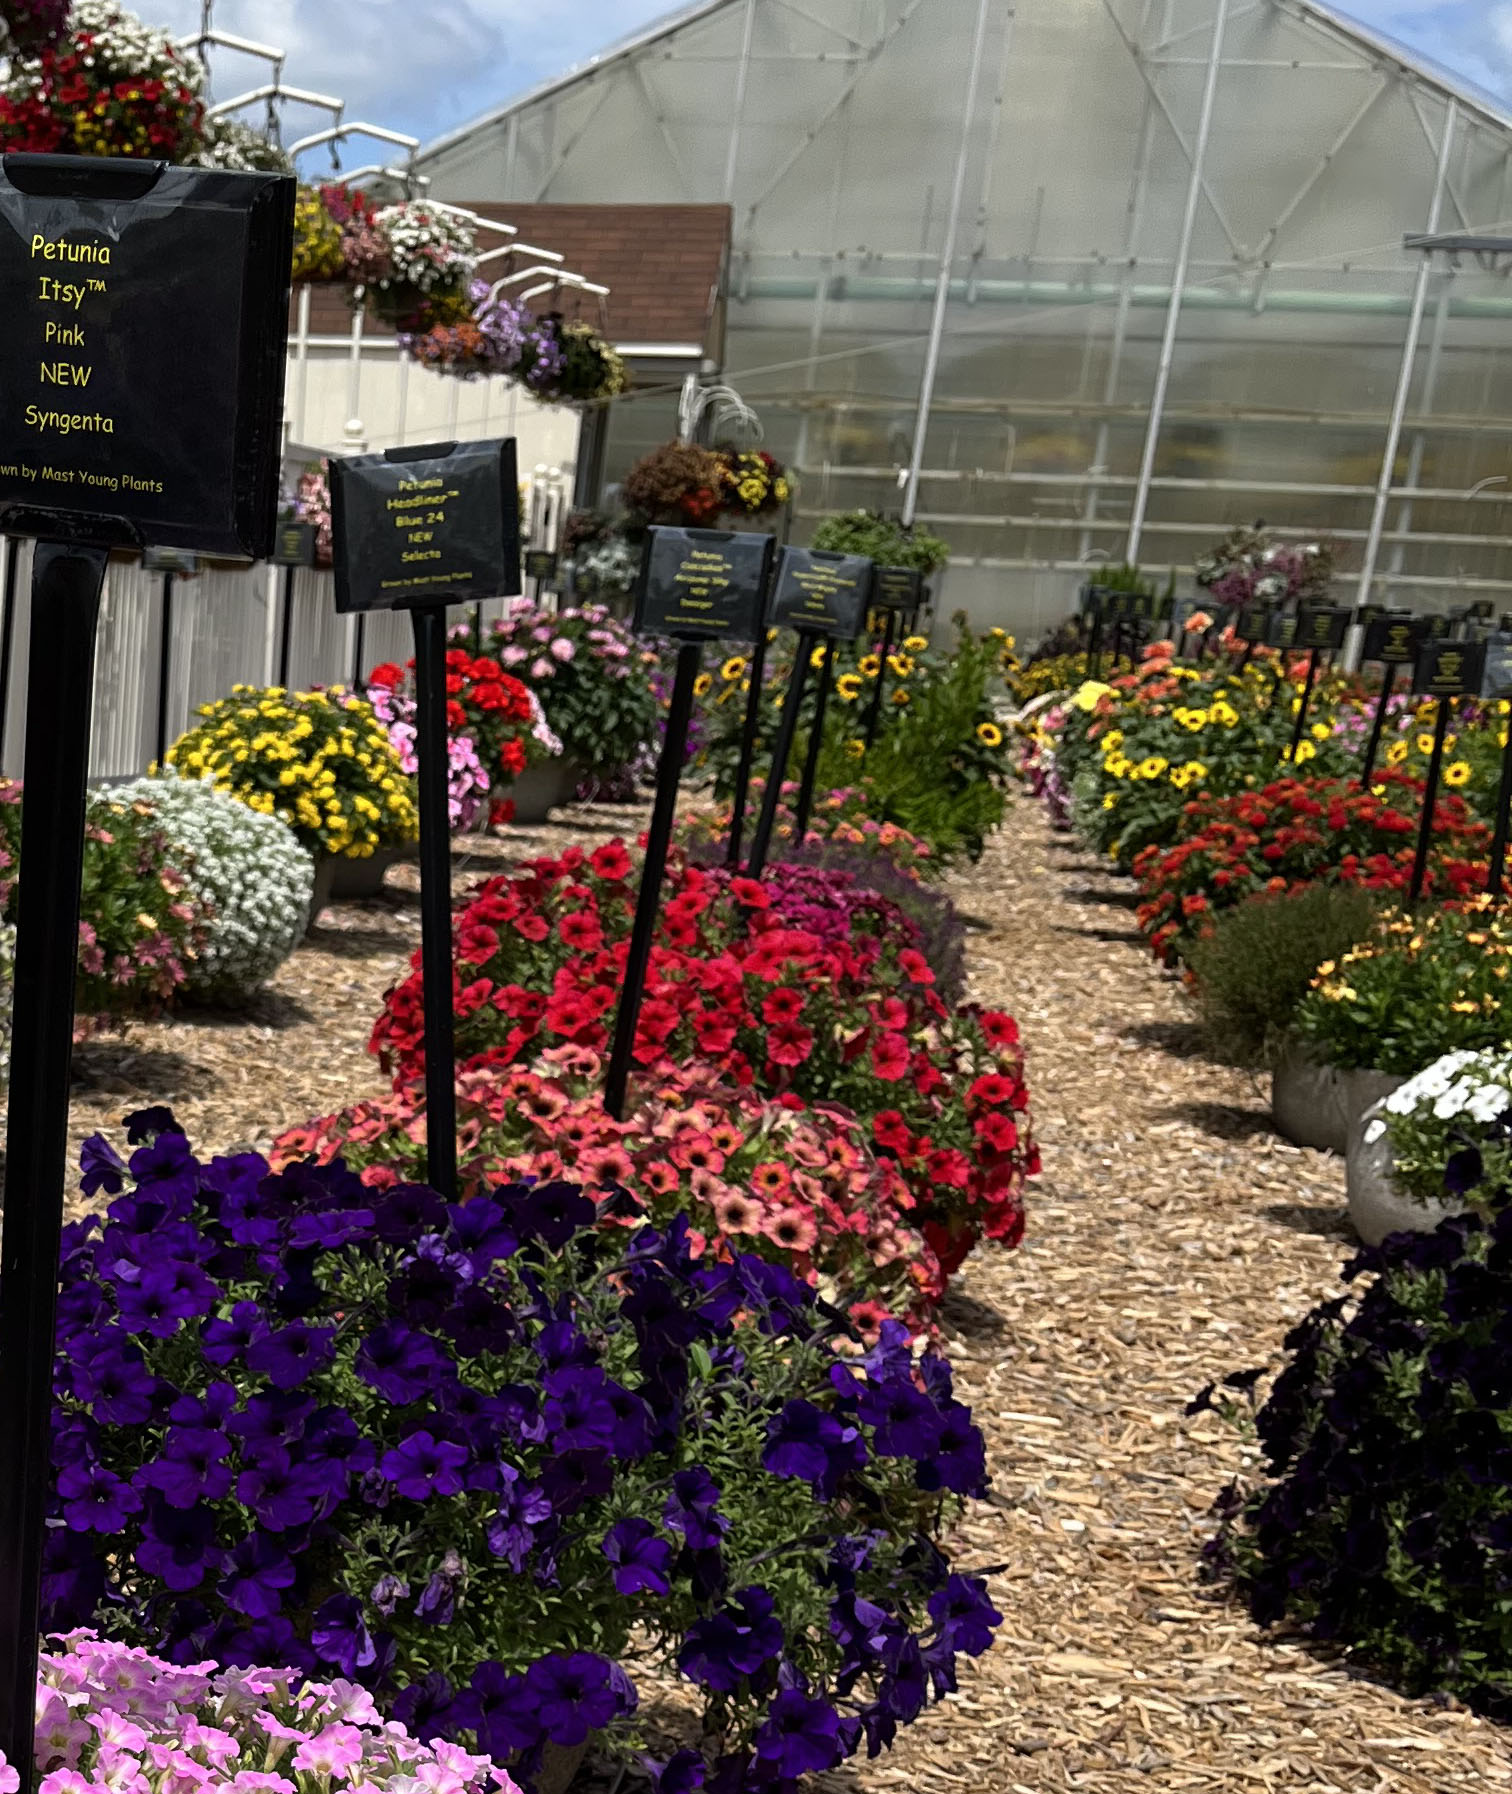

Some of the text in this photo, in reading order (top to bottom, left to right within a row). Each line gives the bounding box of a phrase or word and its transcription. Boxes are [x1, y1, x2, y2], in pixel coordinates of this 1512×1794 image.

[31, 234, 111, 265] Petunia
[45, 321, 85, 347] Pink
[40, 361, 92, 387] NEW
[24, 405, 114, 435] Syngenta
[21, 463, 38, 482] by
[41, 466, 76, 483] Mast
[78, 469, 119, 491] Young
[121, 474, 164, 493] Plants
[399, 479, 443, 491] Petunia
[395, 511, 445, 527] Blue 24
[408, 532, 433, 543] NEW
[401, 551, 441, 562] Selecta
